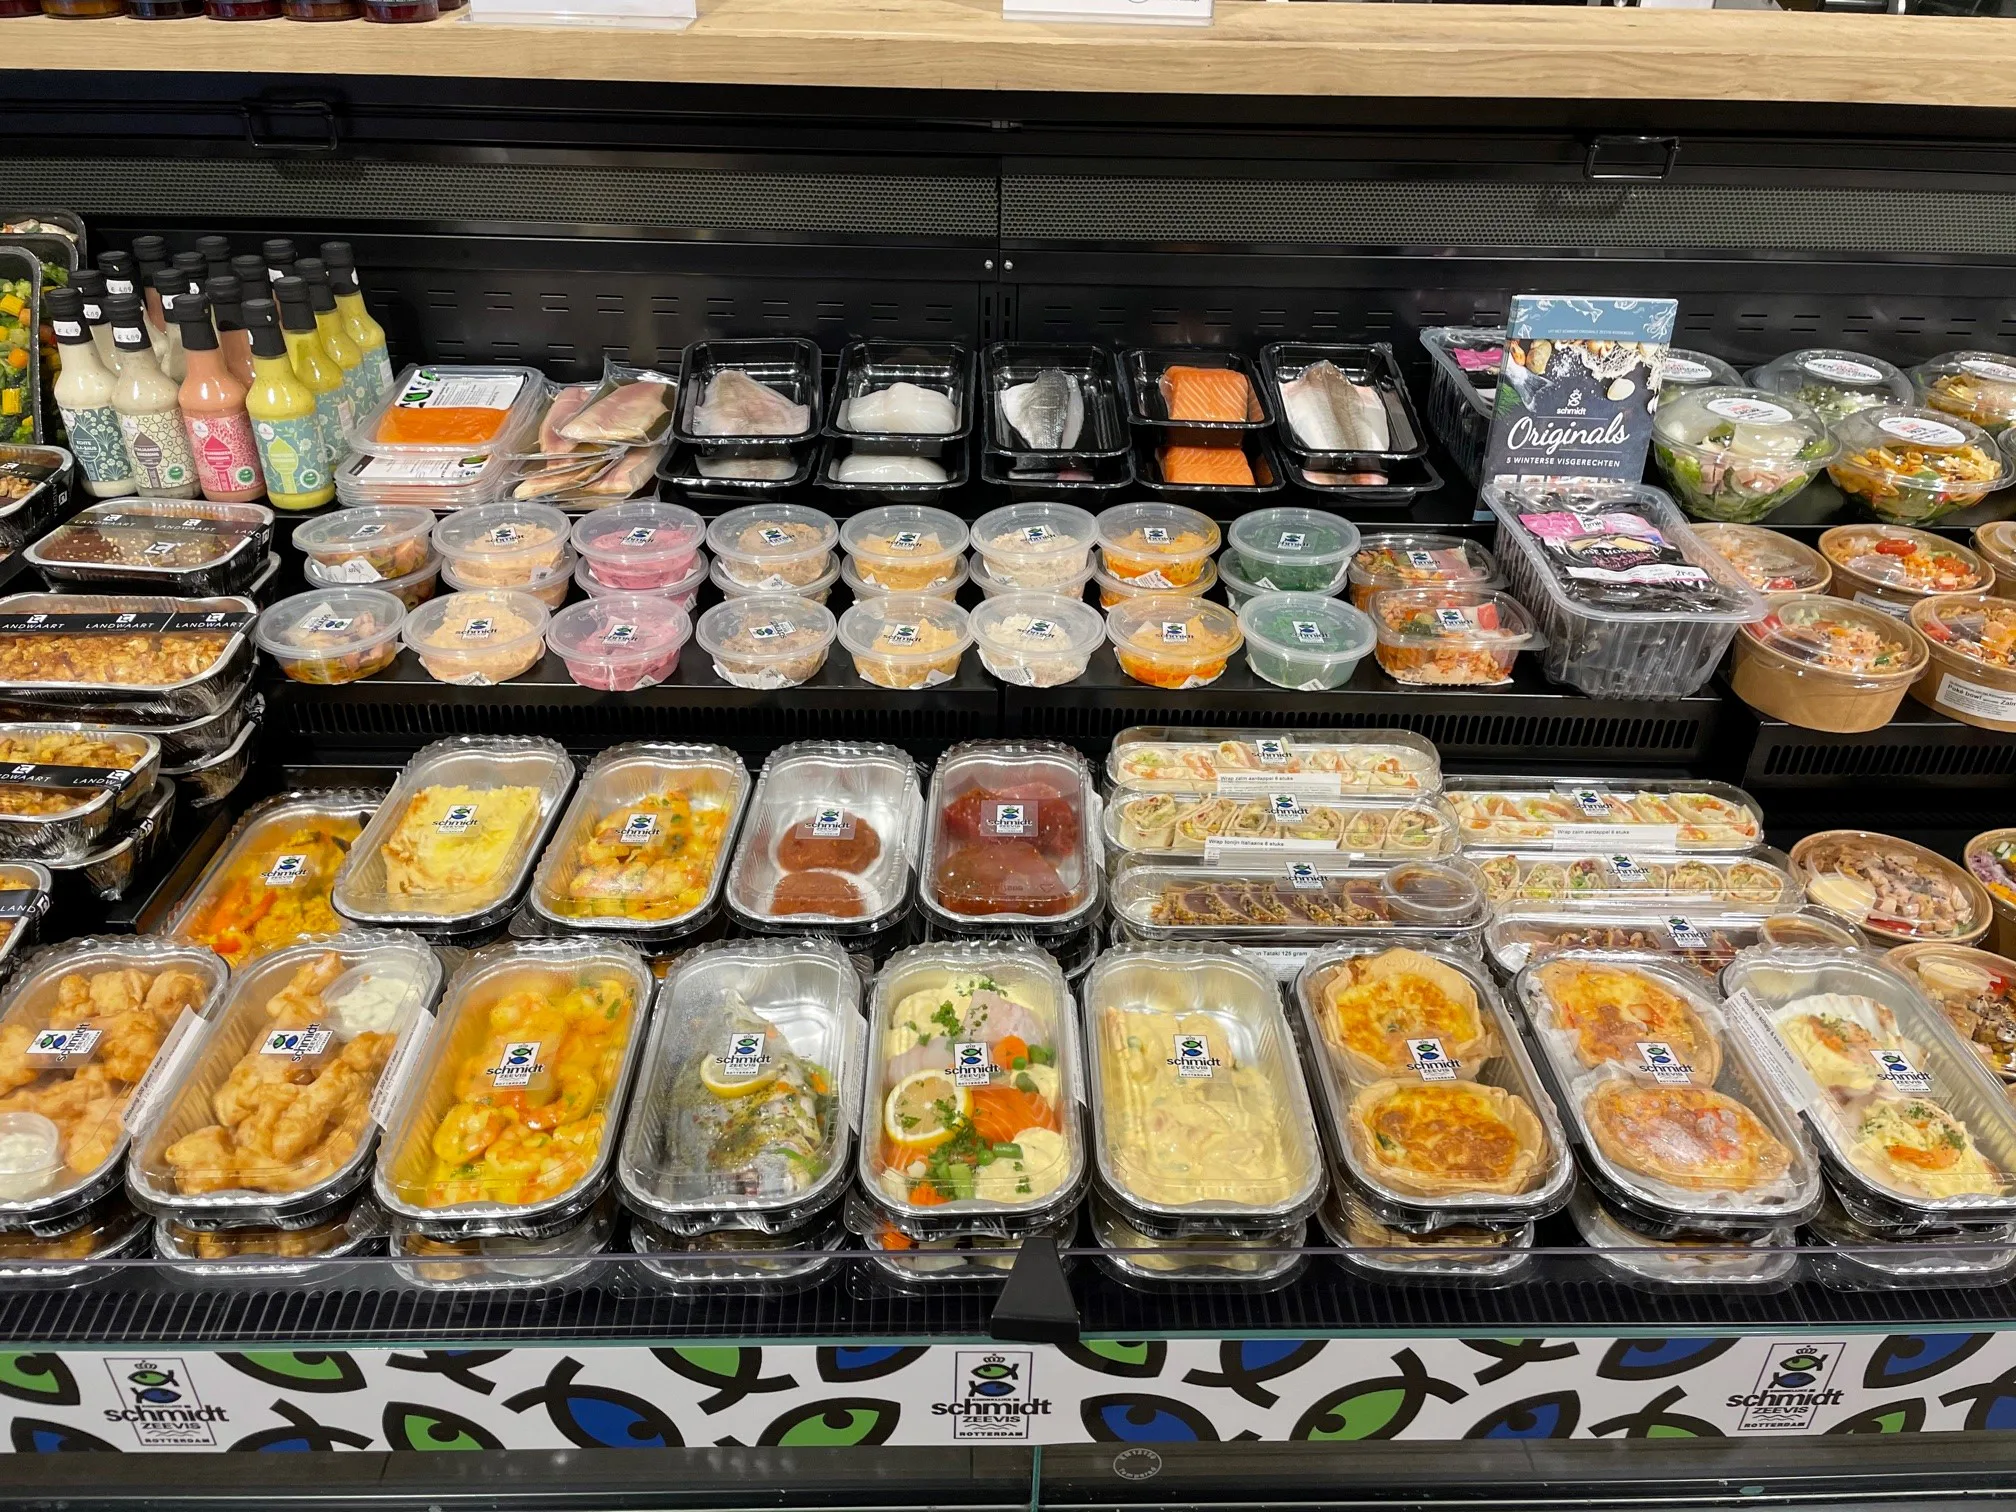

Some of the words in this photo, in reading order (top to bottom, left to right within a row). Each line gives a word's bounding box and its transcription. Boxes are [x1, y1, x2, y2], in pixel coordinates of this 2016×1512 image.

[1556, 407, 1587, 416] schmidt
[1507, 412, 1631, 455] Originals
[1506, 456, 1511, 464] 5
[1513, 456, 1555, 465] WINTERSE
[1557, 457, 1621, 468] VISGERECHTEN
[74, 519, 137, 528] LANDWAART
[154, 524, 217, 533] LANDWAART
[0, 773, 51, 783] DWAART
[72, 778, 122, 790] LANDWA
[1264, 807, 1309, 815] schmidt
[431, 819, 479, 827] schmidt
[804, 821, 850, 830] schmidt
[986, 818, 1033, 826] schmidt
[614, 828, 661, 837] schmidt
[260, 868, 308, 879] schmidt
[1606, 867, 1650, 875] schmidt
[56, 1023, 91, 1062] schmidt
[291, 1023, 320, 1062] schmidt
[716, 1054, 772, 1064] schmidt
[1166, 1057, 1222, 1066] schmidt
[486, 1063, 544, 1075] schmidt
[944, 1063, 1000, 1075] schmidt
[1406, 1059, 1462, 1070] schmidt
[1639, 1063, 1695, 1073] schmidt
[1877, 1071, 1932, 1081] schmidt
[1726, 1388, 1845, 1408] schmidt
[931, 1398, 1052, 1416] schmidt
[1752, 1406, 1809, 1414] ZEEVIS
[103, 1405, 230, 1422] schmidt
[141, 1422, 201, 1430] ZEEVIS
